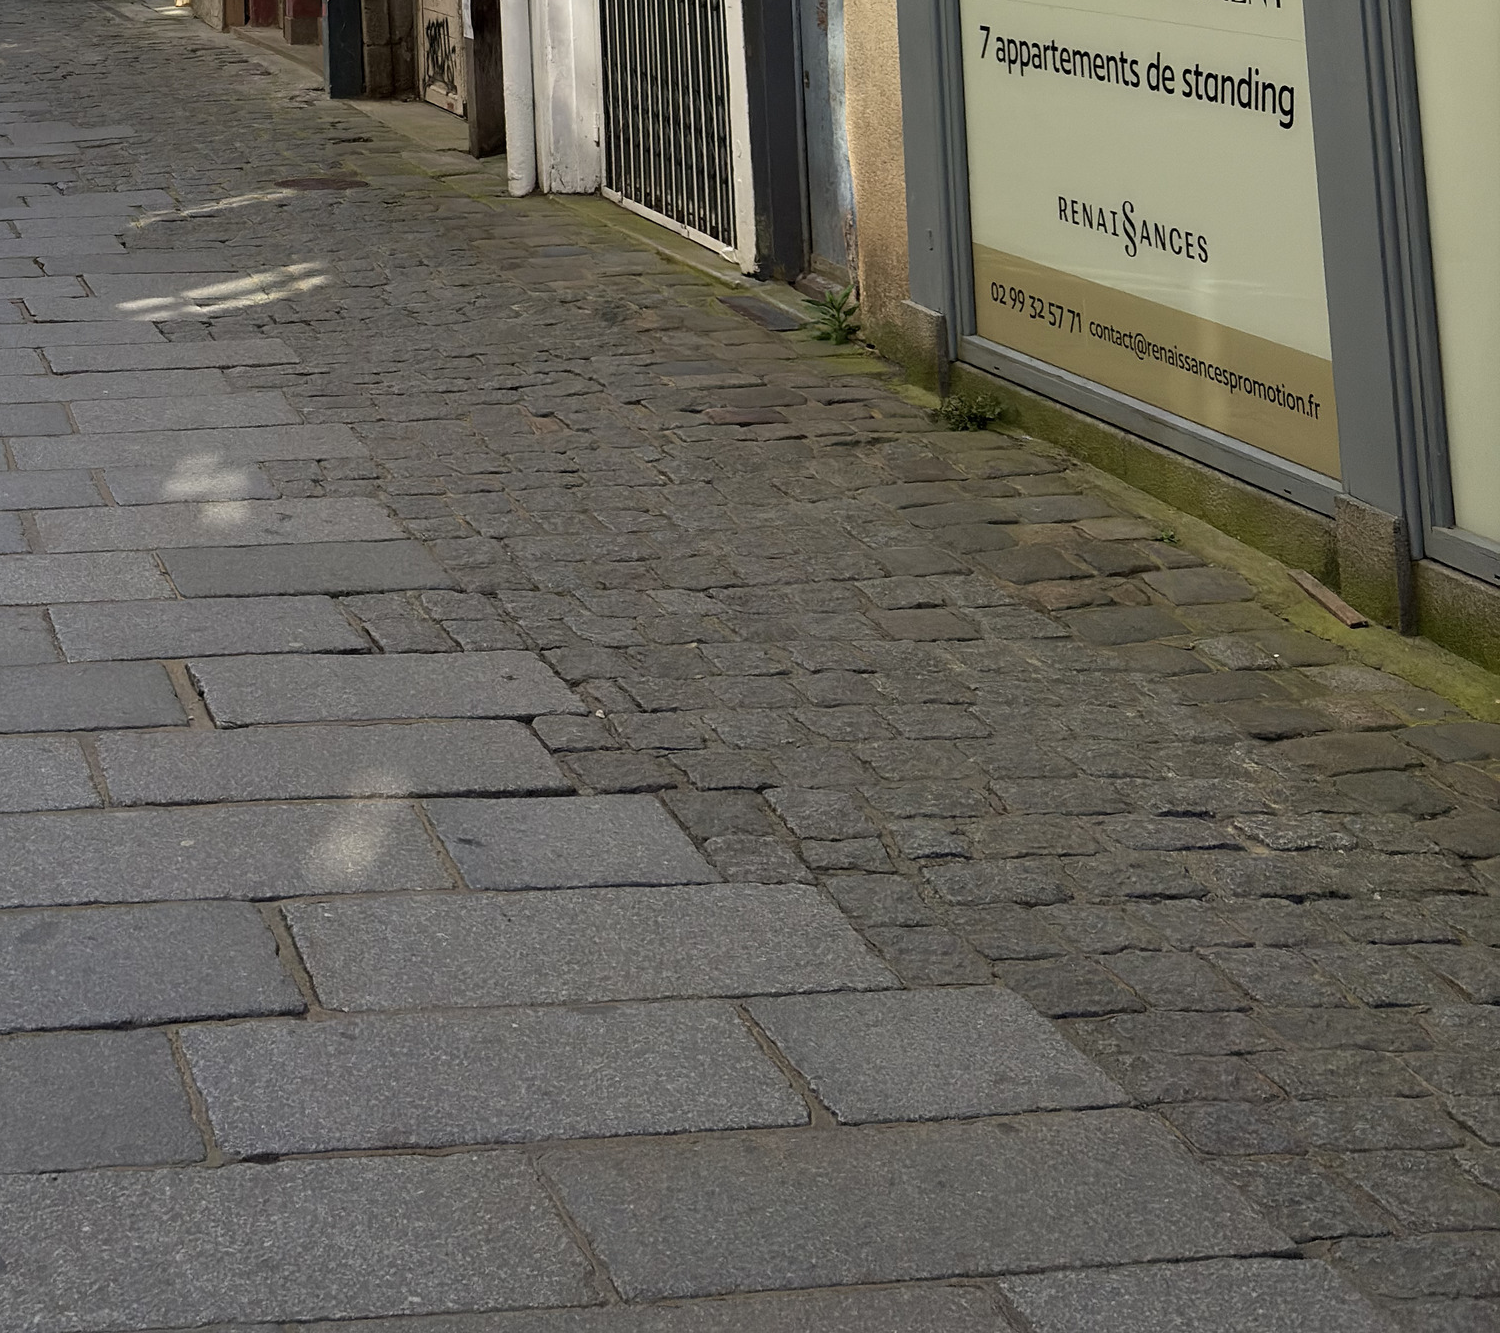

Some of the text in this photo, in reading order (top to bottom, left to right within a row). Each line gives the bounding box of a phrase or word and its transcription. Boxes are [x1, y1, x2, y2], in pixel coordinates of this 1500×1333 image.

[979, 25, 1295, 129] 7 appartements de standing
[991, 281, 1321, 421] 02 99 32 57 71 contact@renaissancespromotion.fr
